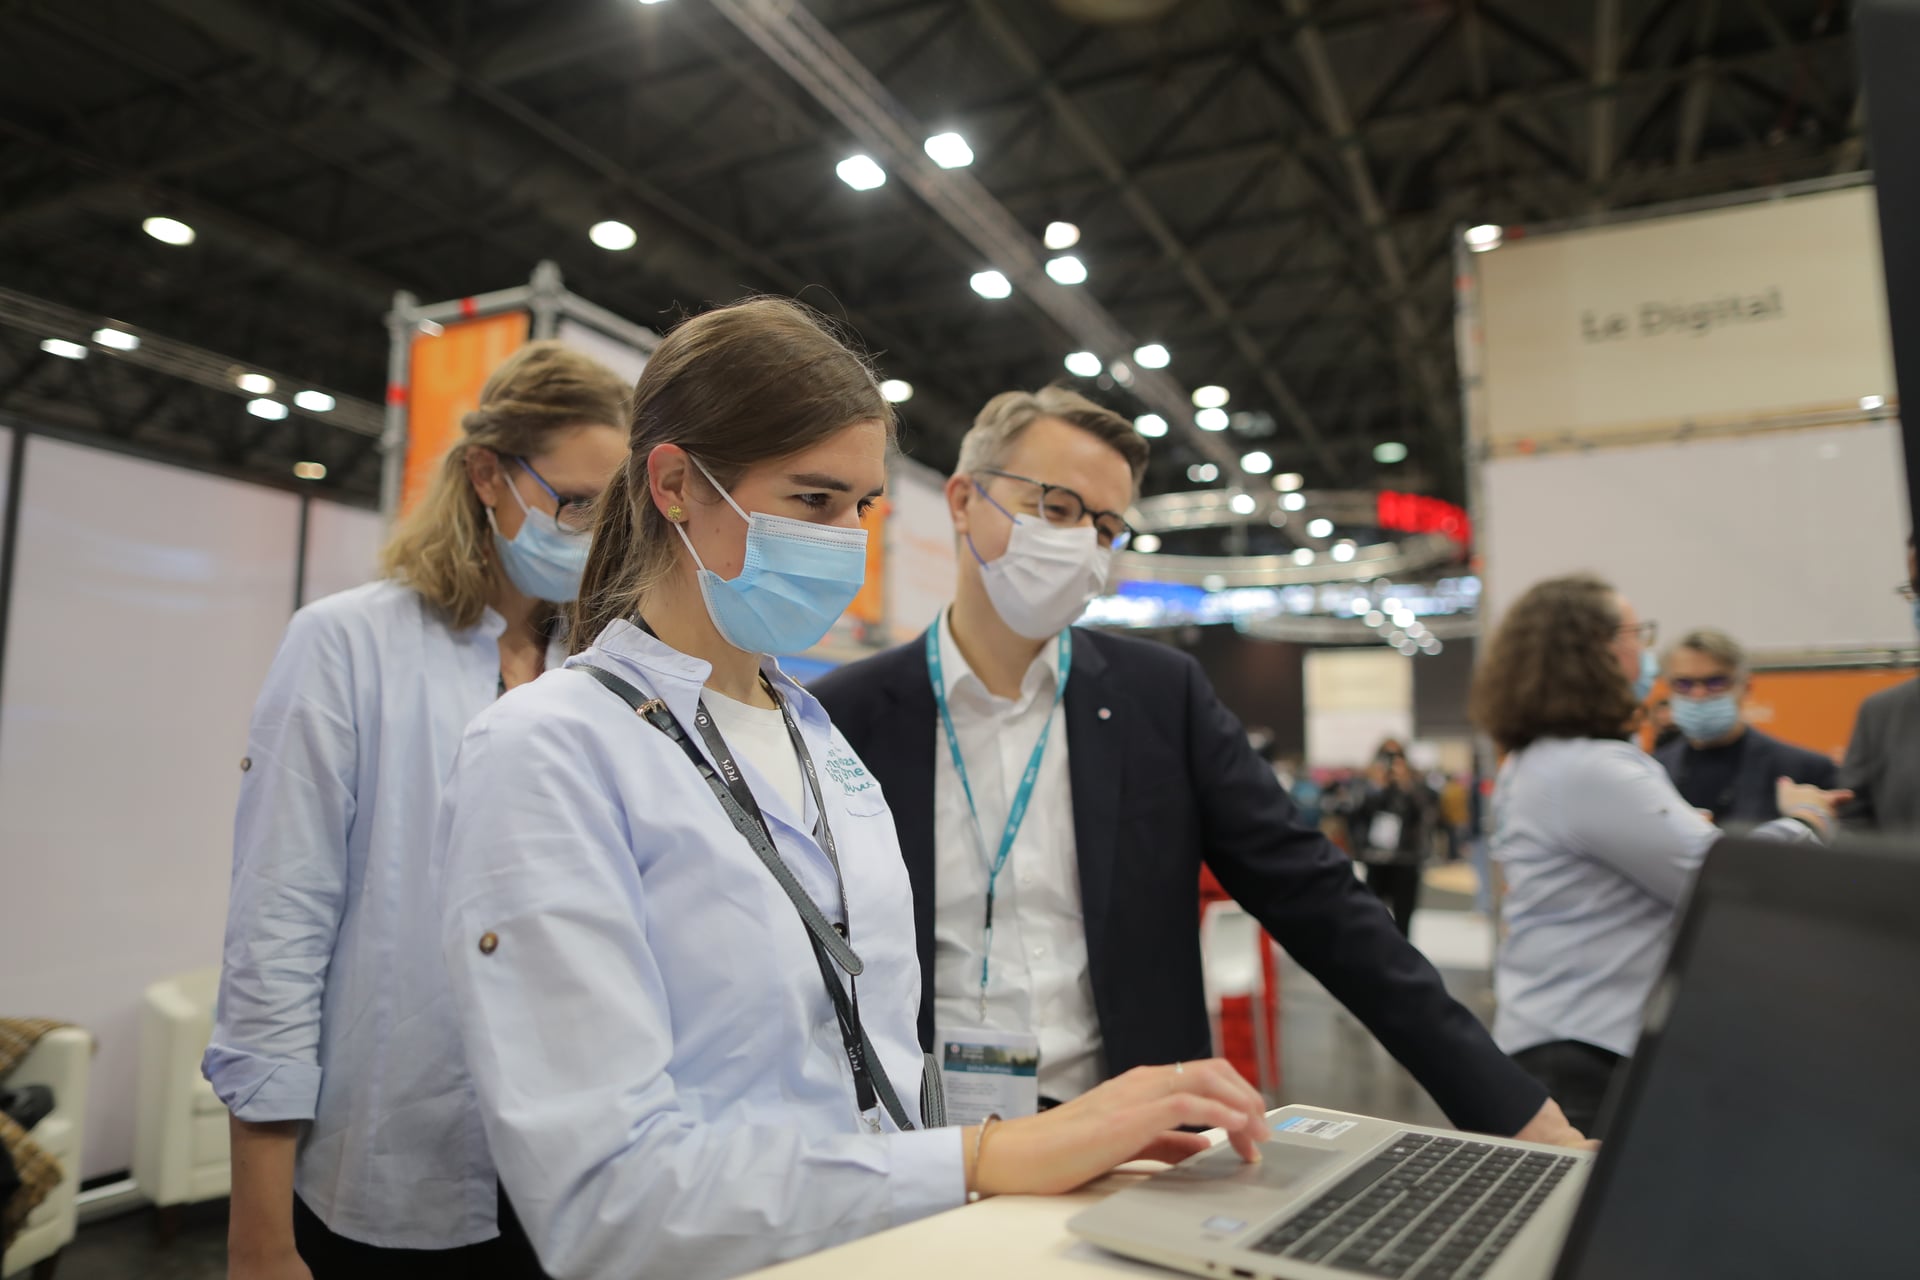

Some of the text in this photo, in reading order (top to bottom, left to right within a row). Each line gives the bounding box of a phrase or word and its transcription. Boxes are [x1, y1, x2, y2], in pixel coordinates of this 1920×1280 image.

[1580, 286, 1784, 342] Le Digital
[721, 759, 739, 782] PEPS
